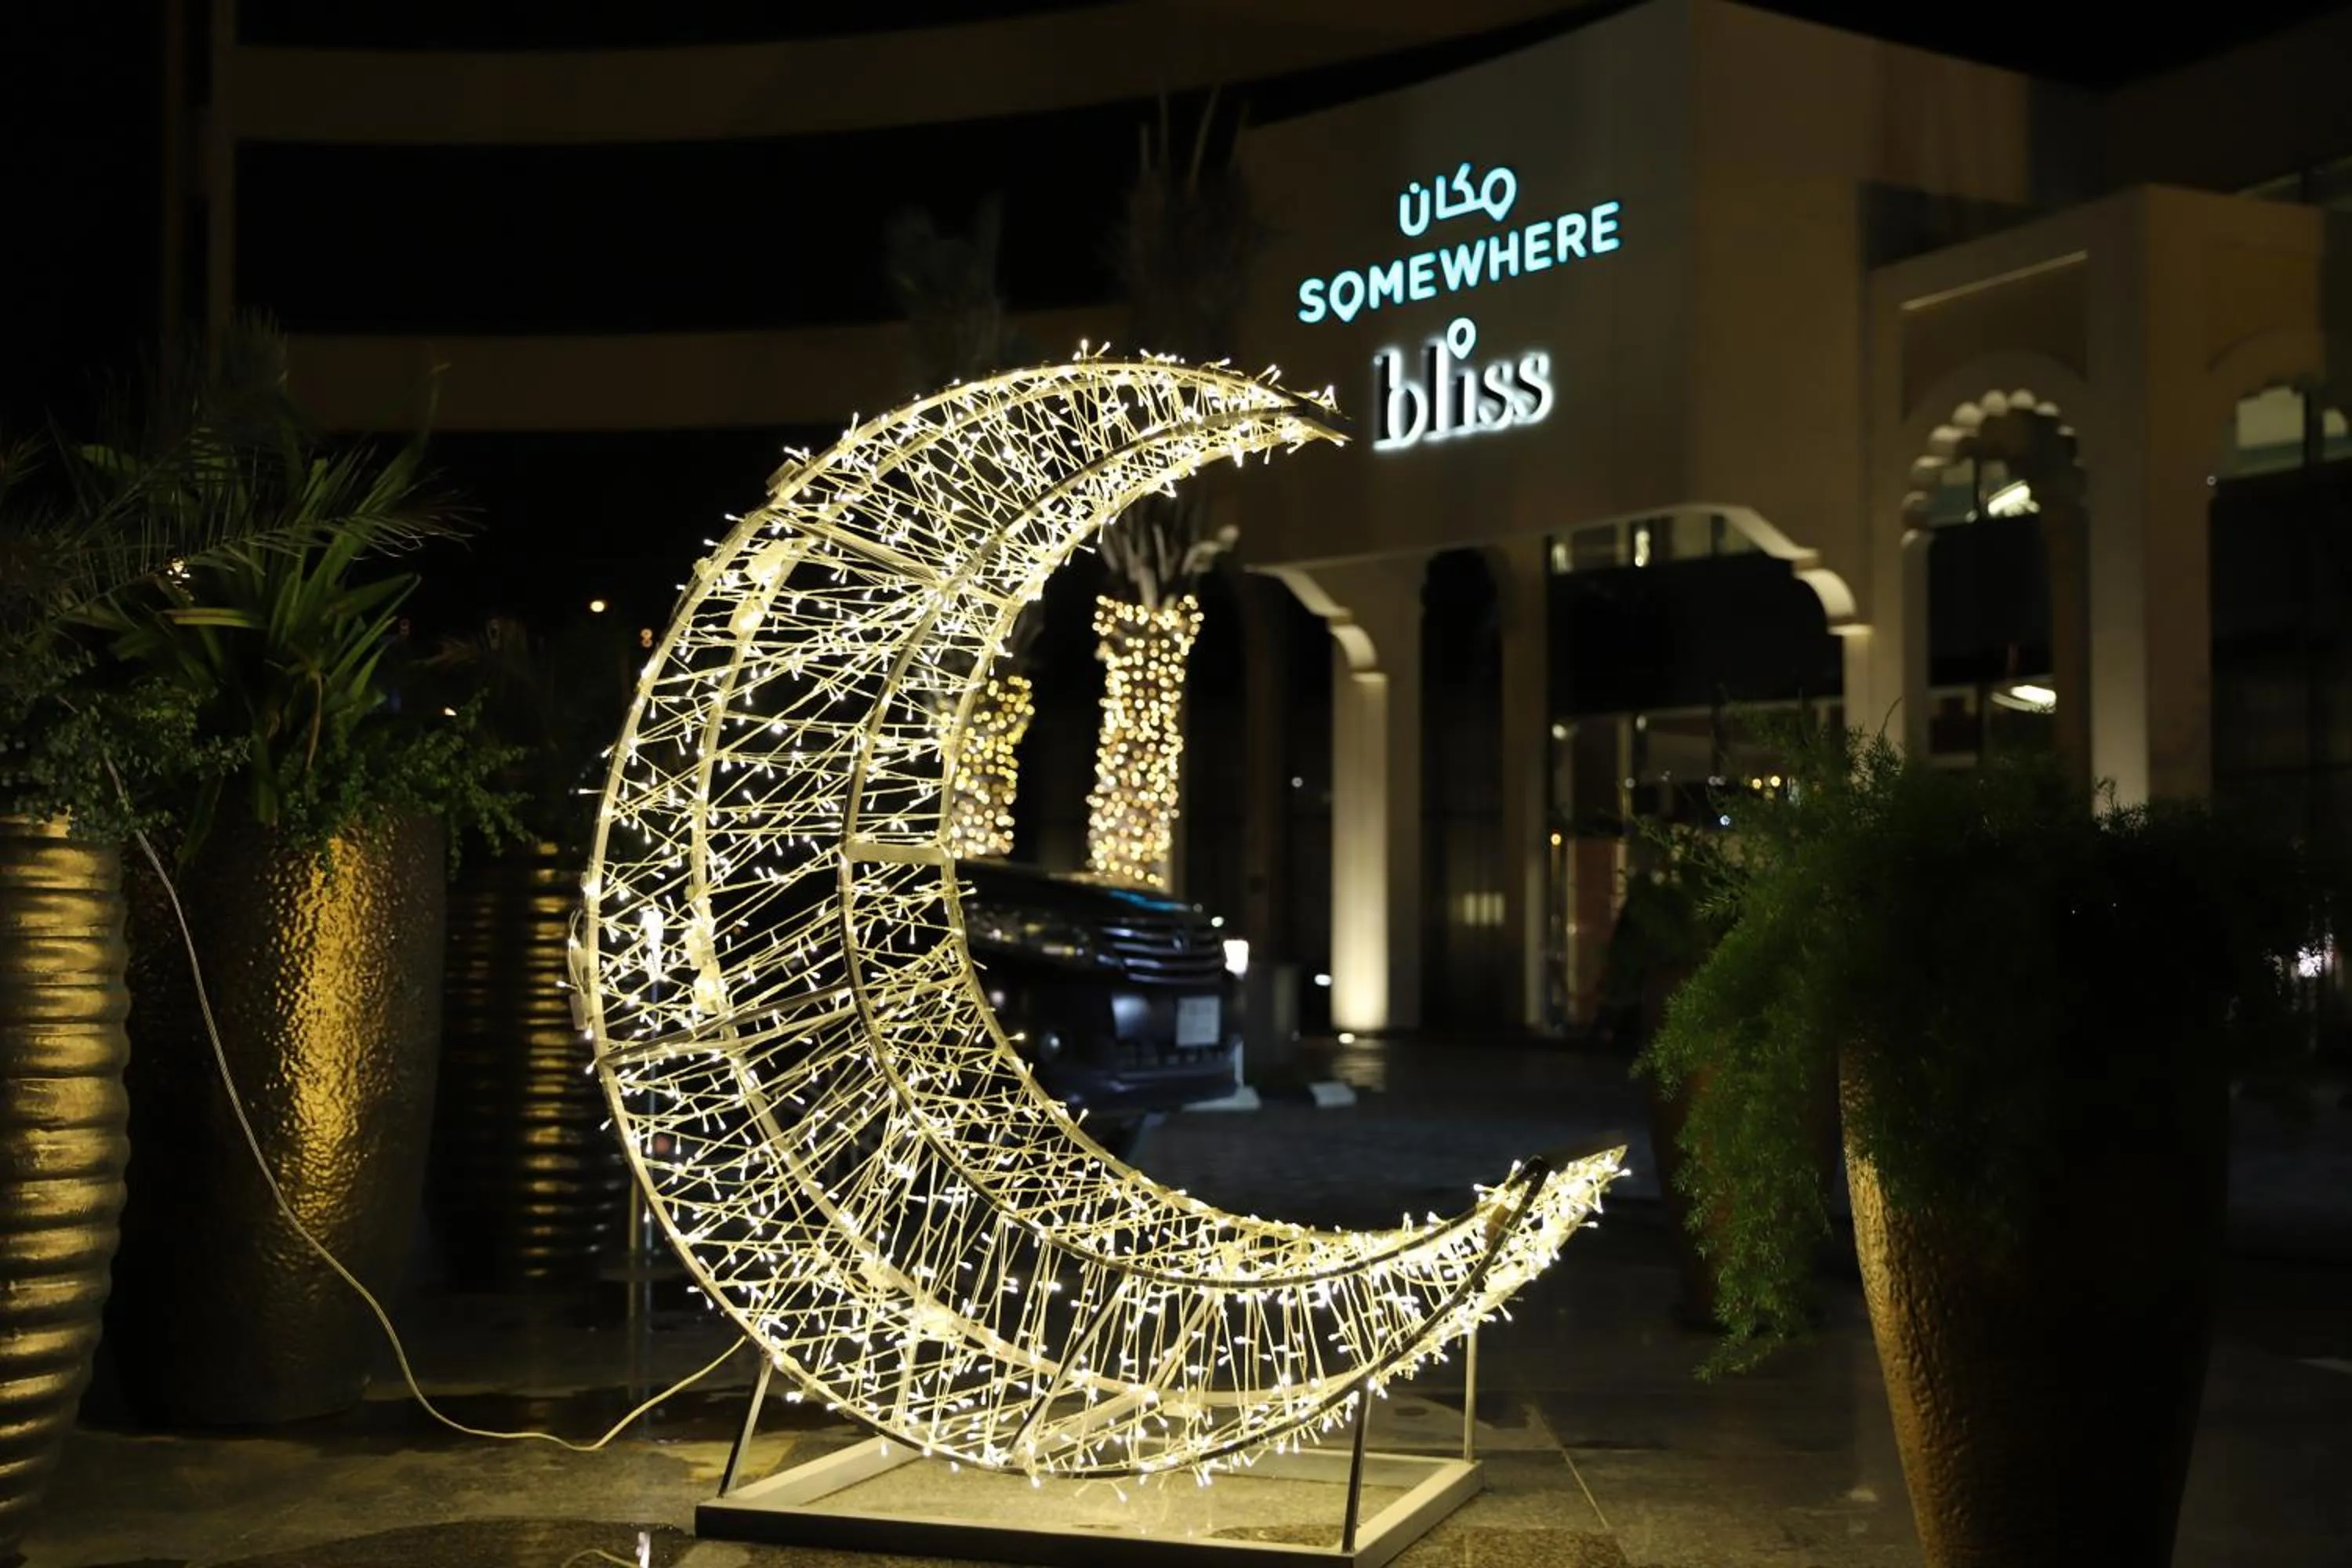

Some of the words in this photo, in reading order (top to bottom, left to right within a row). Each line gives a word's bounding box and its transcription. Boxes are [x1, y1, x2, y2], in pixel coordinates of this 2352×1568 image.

[1399, 162, 1518, 237] مكان
[1298, 201, 1621, 323] SOMEWHERE
[1373, 317, 1554, 452] bliss
